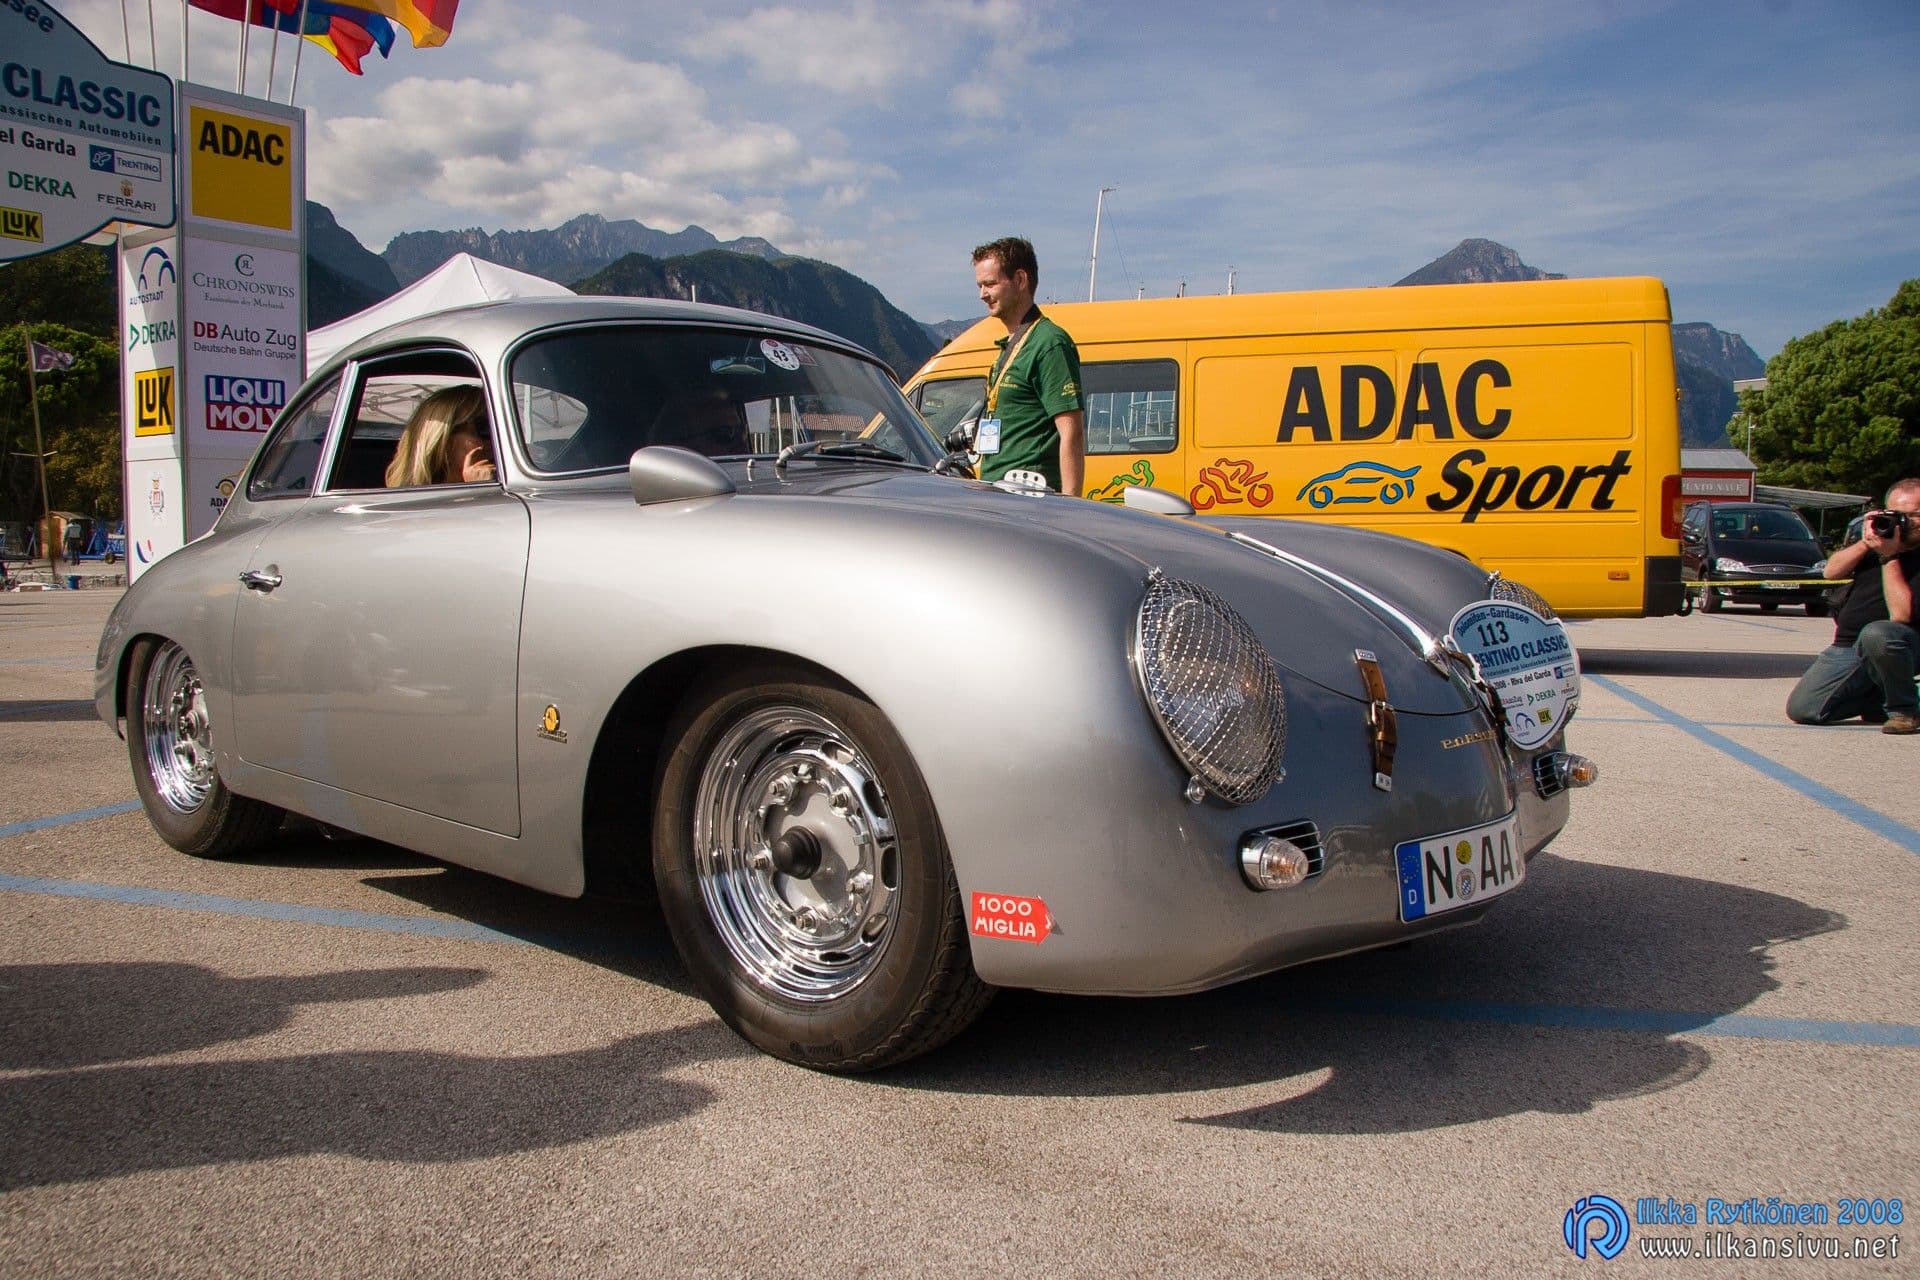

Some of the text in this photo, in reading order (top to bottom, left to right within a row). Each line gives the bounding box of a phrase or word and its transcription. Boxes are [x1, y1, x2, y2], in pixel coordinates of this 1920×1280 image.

[0, 0, 53, 32] see
[2, 62, 161, 128] CLASSIC
[22, 131, 76, 156] Garda
[79, 119, 161, 146] Automobilen
[200, 120, 284, 166] ADAC
[117, 157, 159, 173] TRENTINO
[8, 171, 76, 198] DEKRA
[98, 193, 156, 211] FERRARI
[130, 290, 164, 305] AUTOSTADT
[142, 320, 177, 345] DEKRA
[194, 321, 218, 339] DB
[266, 328, 297, 351] Zug
[194, 342, 297, 361] Deutsche Bahn Gruppe
[209, 377, 282, 405] LIQUI
[1276, 358, 1513, 443] ADAC
[210, 404, 284, 431] MOLY
[1425, 448, 1633, 524] Sport
[1477, 620, 1510, 648] 113
[1521, 634, 1568, 659] CLASSIC
[1510, 677, 1524, 686] Riva
[1523, 673, 1534, 683] del
[1533, 670, 1552, 681] Garda
[1535, 688, 1557, 702] DEKRA
[1424, 845, 1455, 905] N
[979, 896, 1033, 917] 1000
[1408, 888, 1418, 905] D
[975, 916, 1037, 938] MIGLIA
